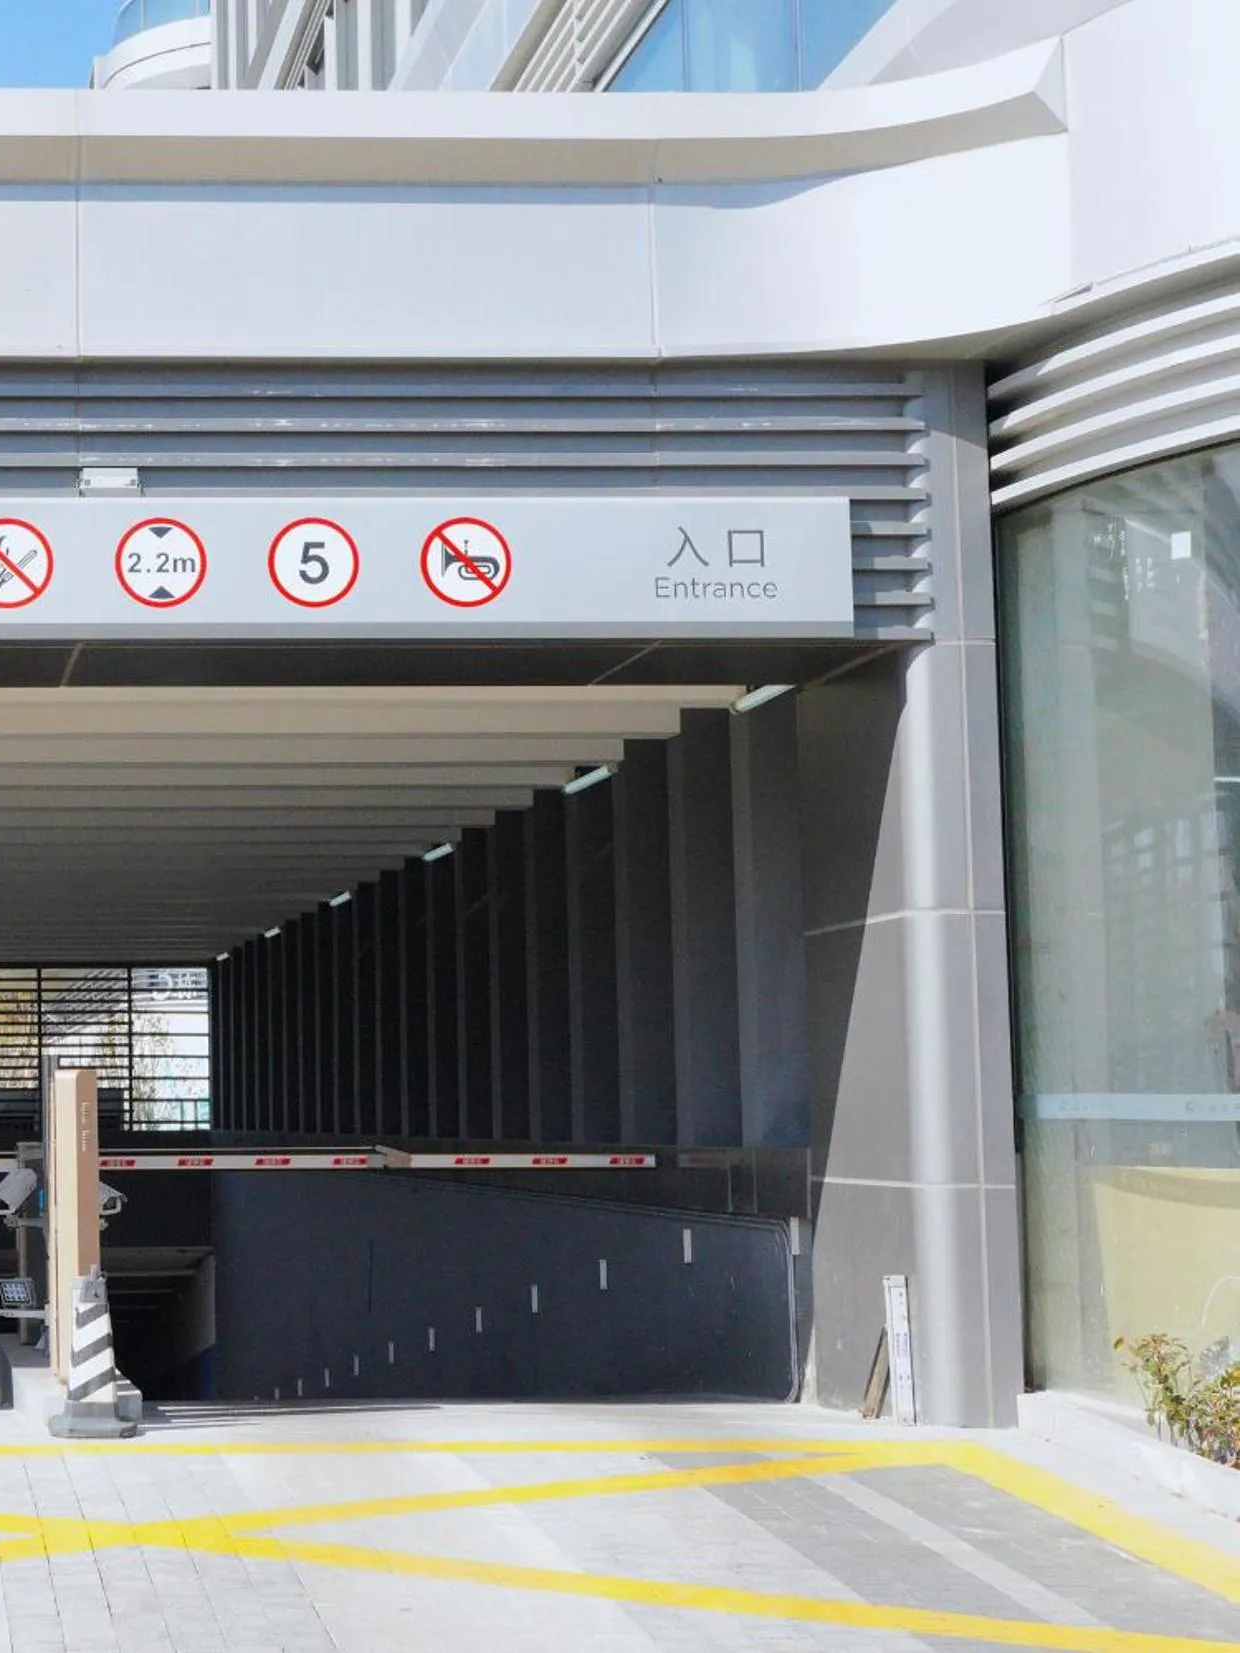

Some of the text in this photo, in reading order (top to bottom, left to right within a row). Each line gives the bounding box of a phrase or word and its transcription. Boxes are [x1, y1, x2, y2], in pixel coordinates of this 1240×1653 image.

[127, 551, 197, 574] 2.2m
[666, 525, 766, 568] 入口
[298, 541, 331, 586] 5
[654, 576, 778, 600] Entrance
